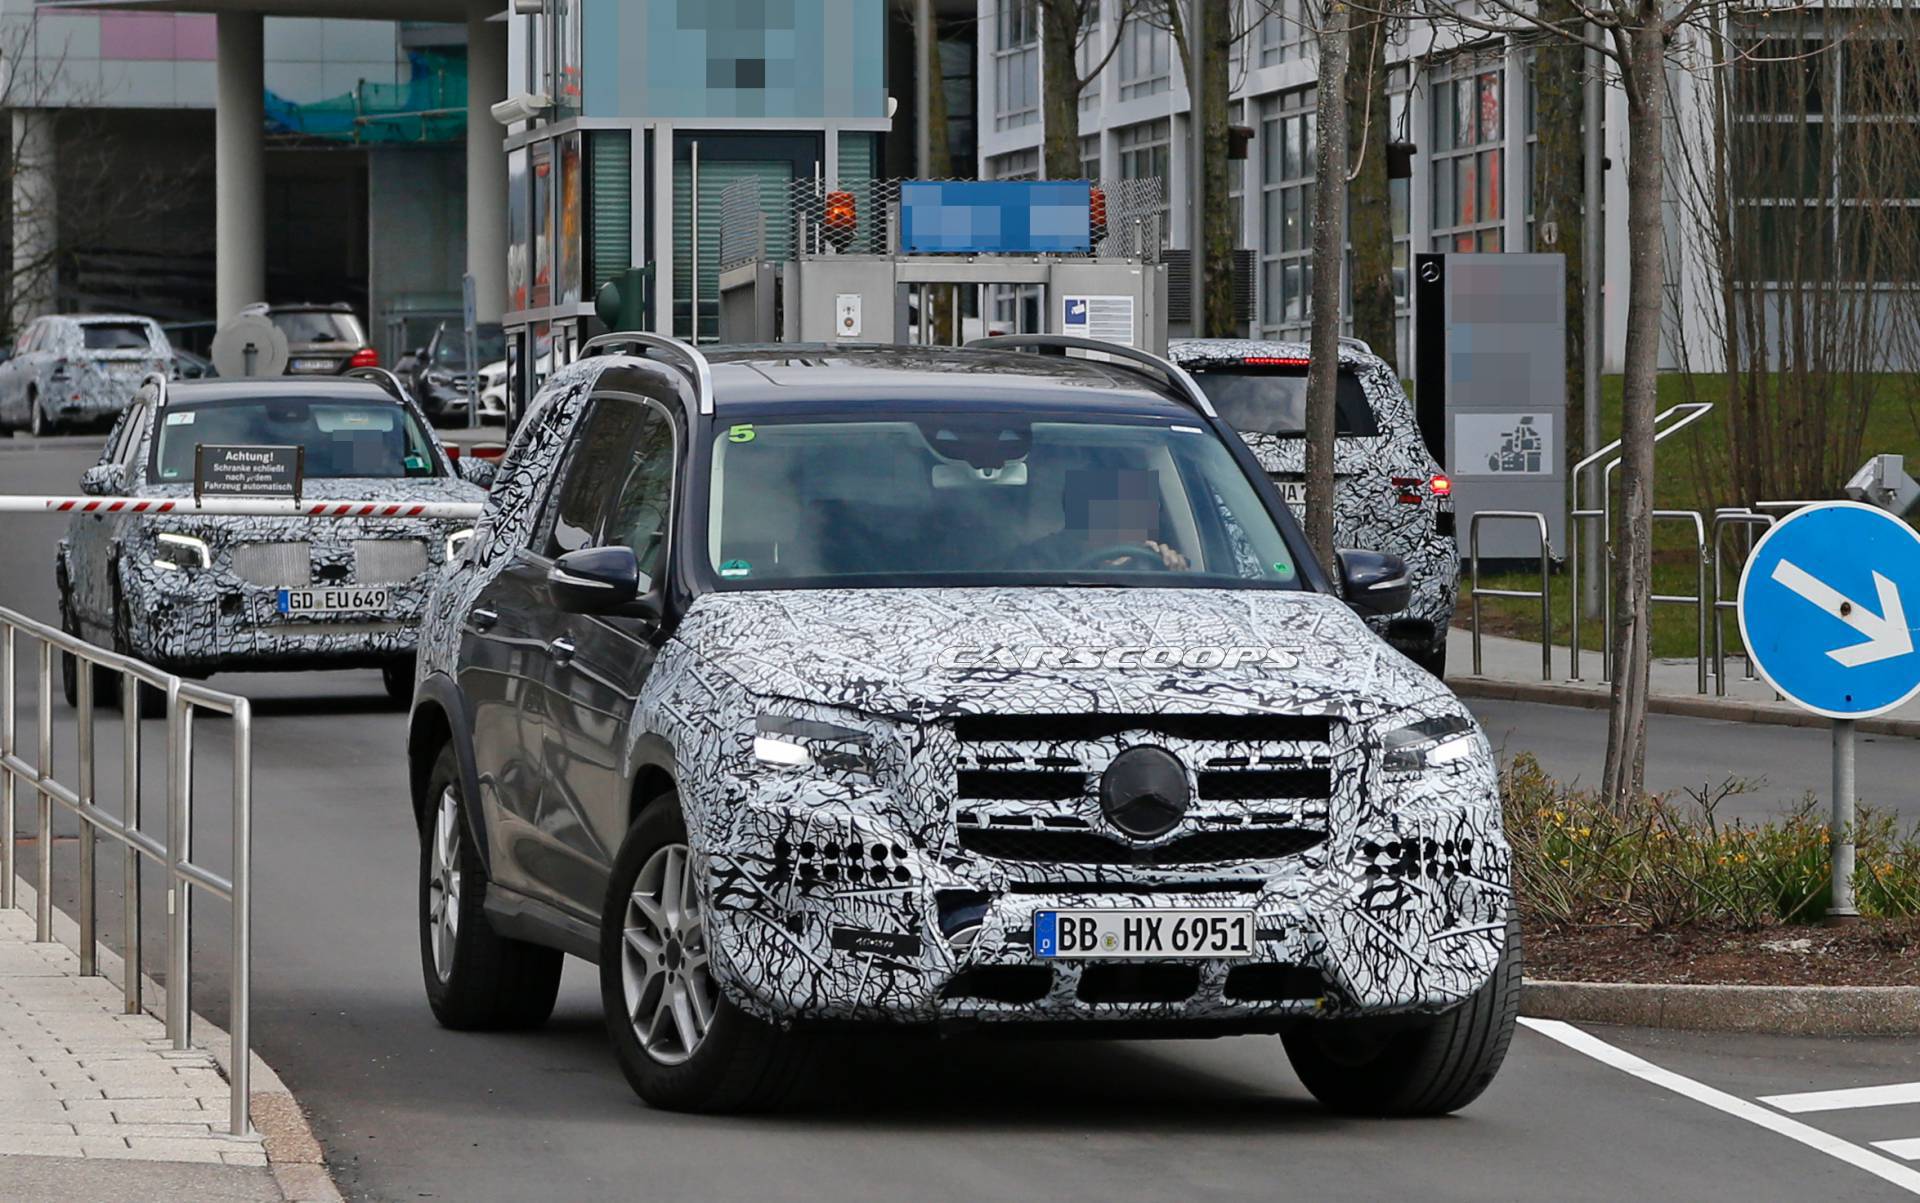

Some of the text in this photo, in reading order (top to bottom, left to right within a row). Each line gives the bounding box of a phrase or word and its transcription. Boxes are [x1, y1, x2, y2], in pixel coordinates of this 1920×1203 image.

[728, 423, 756, 443] 5
[225, 451, 274, 464] Achtung!
[213, 463, 285, 473] Schranke schließt
[225, 473, 245, 481] nach
[204, 481, 293, 491] Fahrzeug automatisch
[290, 591, 385, 609] GD EU 649
[1058, 917, 1098, 951] BB
[1123, 917, 1163, 951] HX
[1172, 917, 1248, 951] 6951
